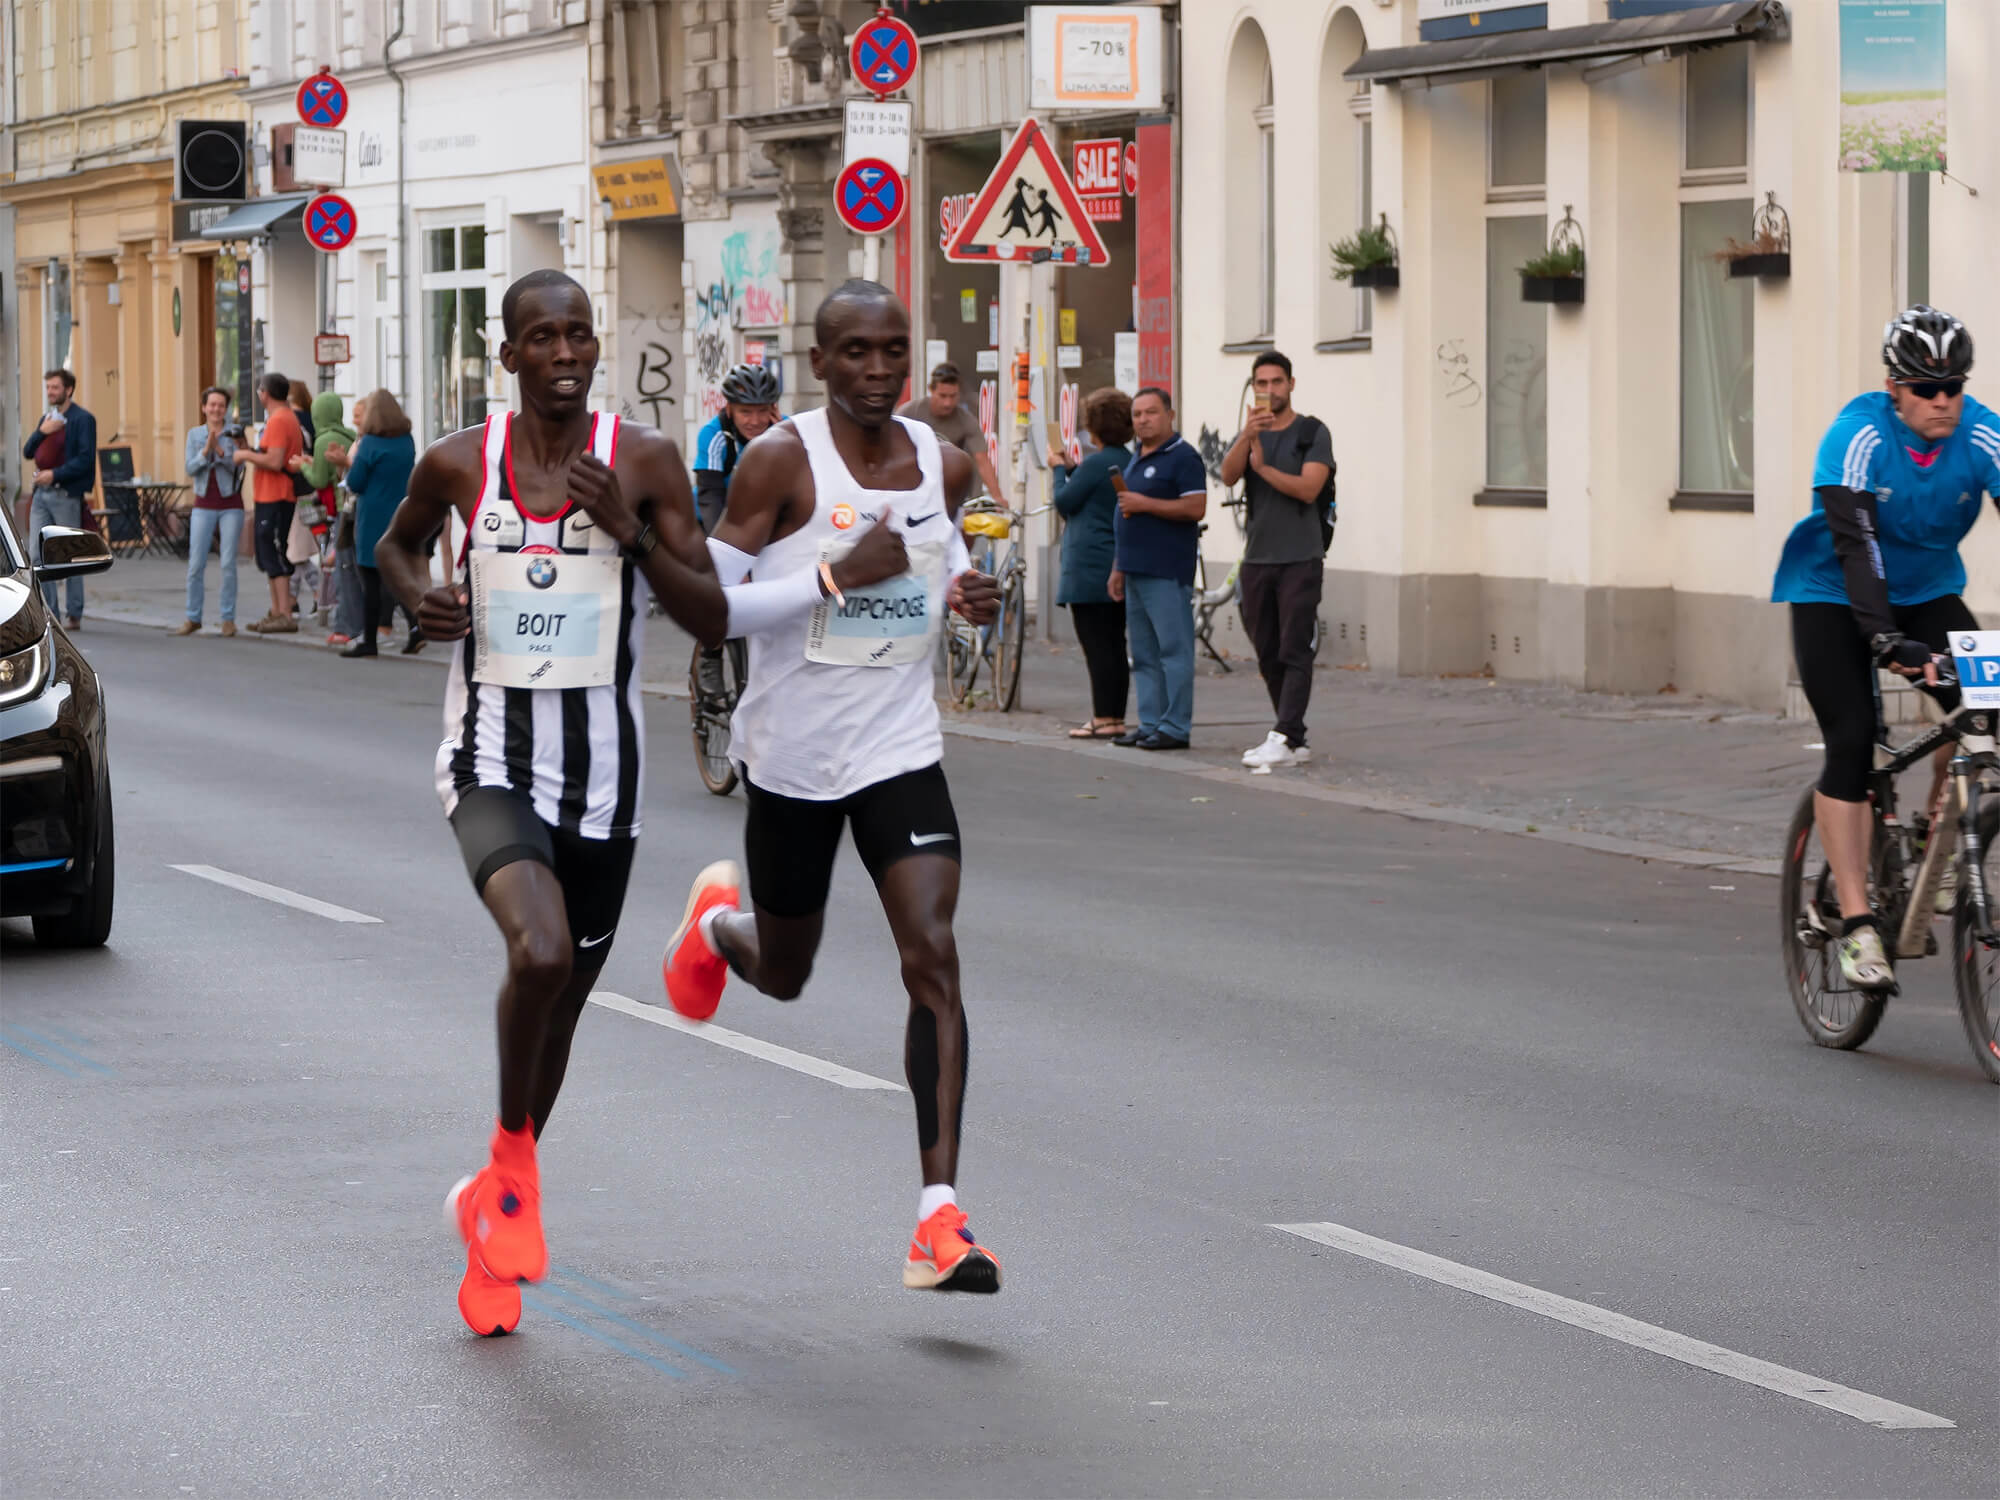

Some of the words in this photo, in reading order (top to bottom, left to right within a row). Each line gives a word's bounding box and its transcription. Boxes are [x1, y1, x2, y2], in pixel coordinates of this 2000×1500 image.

[1078, 40, 1125, 56] -70%
[1077, 147, 1118, 190] SALE
[516, 613, 567, 637] BOIT
